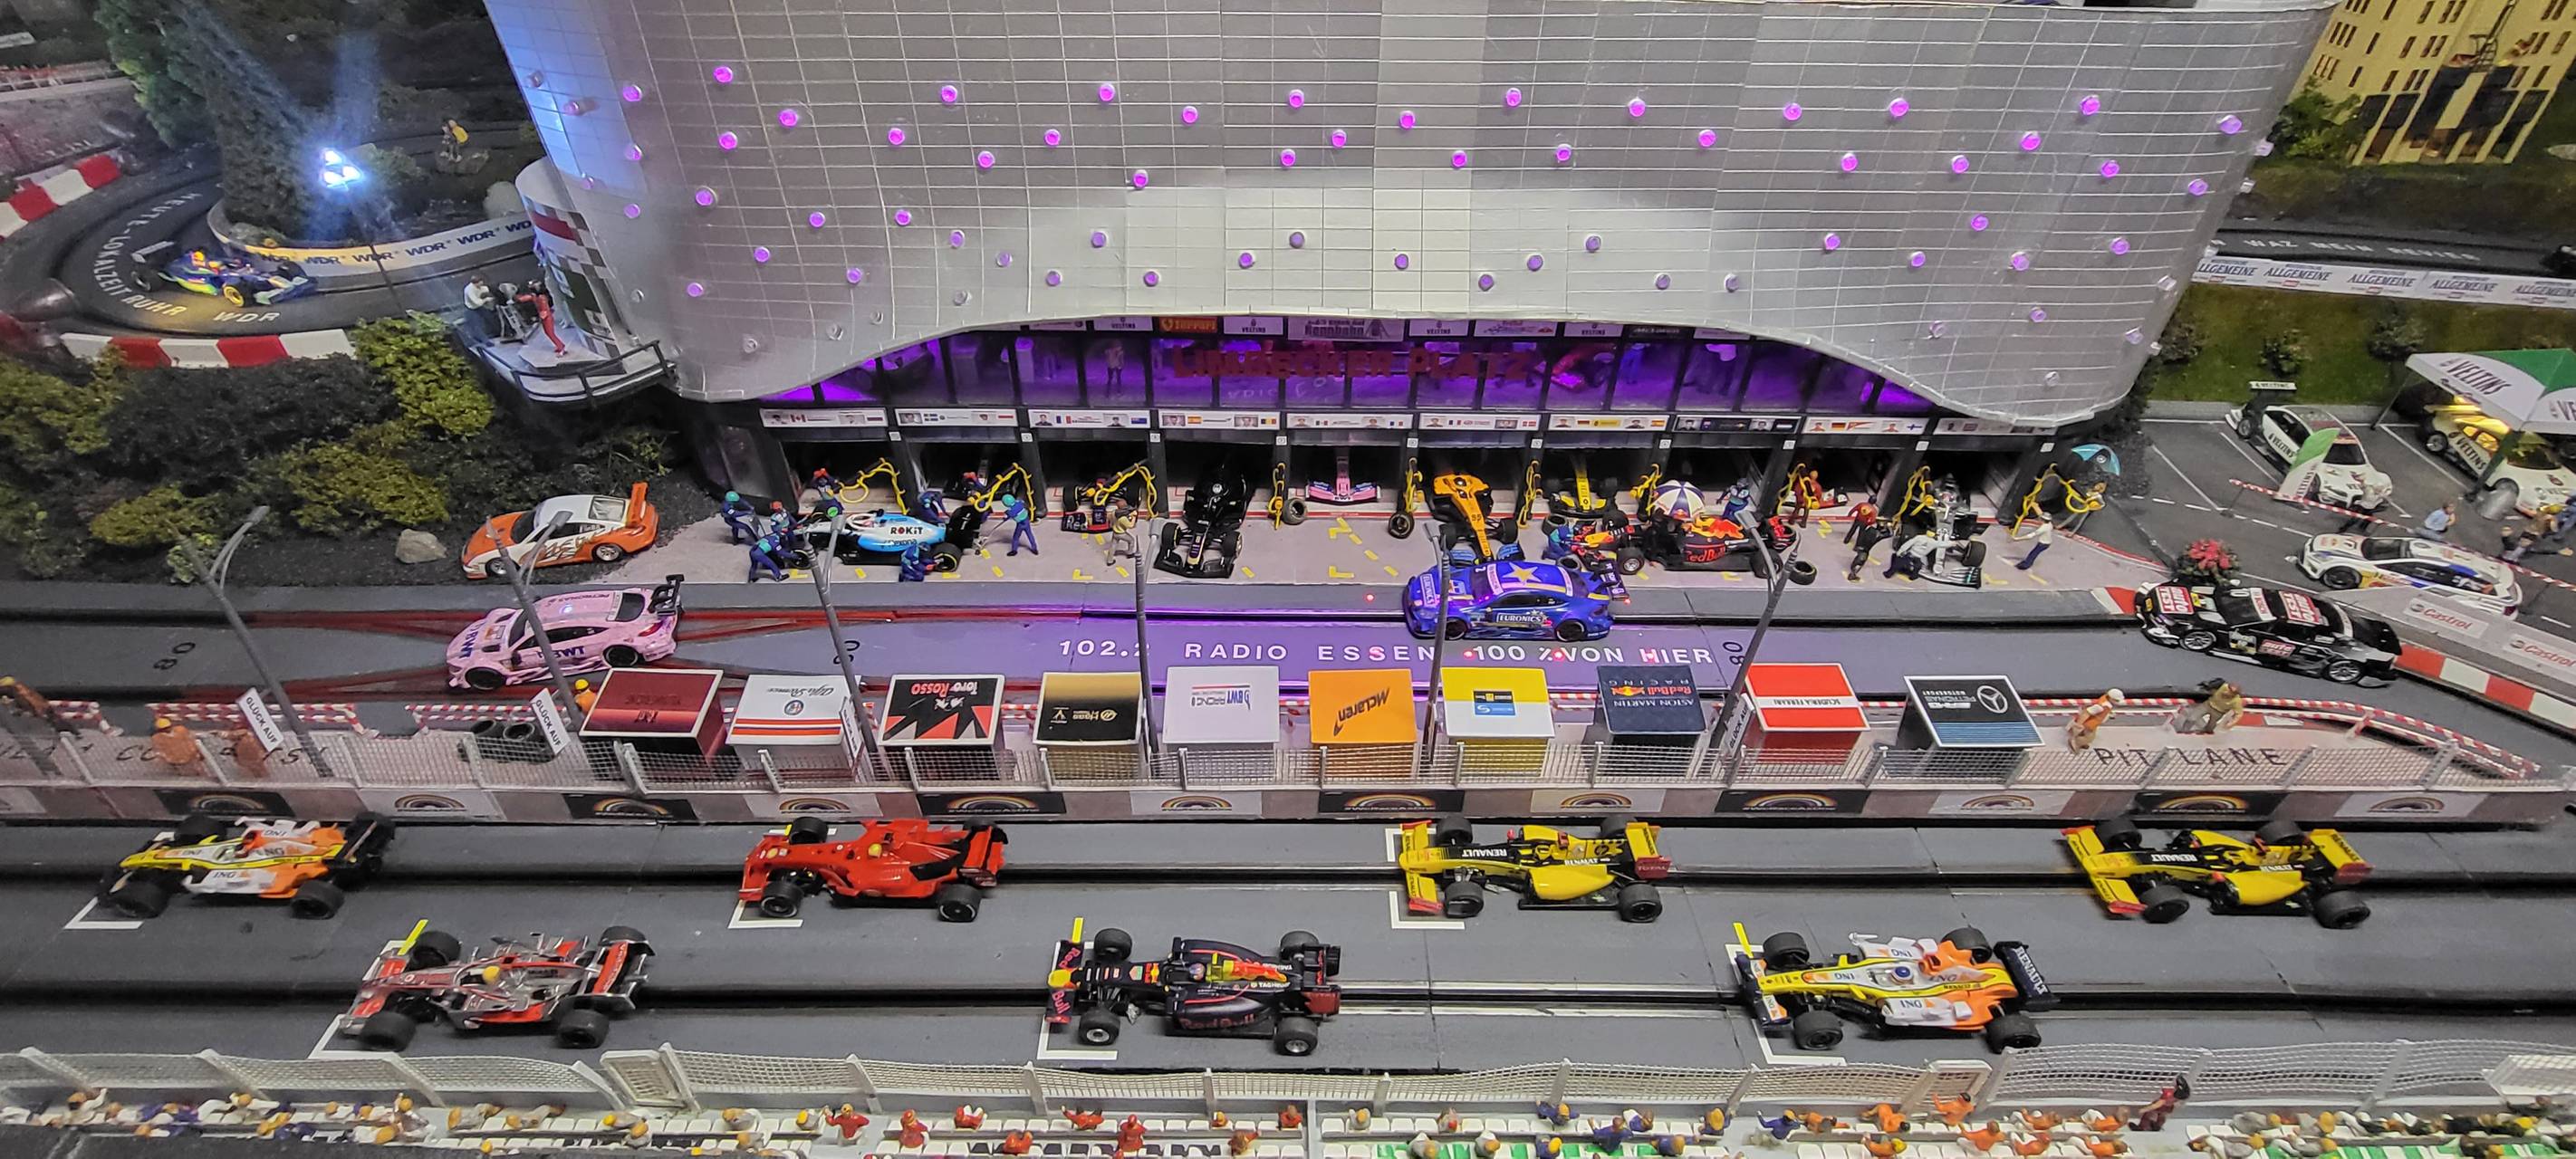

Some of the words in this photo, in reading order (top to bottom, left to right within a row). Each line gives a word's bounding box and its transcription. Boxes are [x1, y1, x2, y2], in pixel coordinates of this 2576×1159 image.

[505, 219, 533, 233] WD
[457, 228, 496, 245] WDR
[405, 240, 447, 257] WDR
[351, 250, 395, 263] WDR
[2197, 262, 2258, 277] LLGEMEINE
[2264, 266, 2332, 282] ALLGEMEINE
[2347, 273, 2416, 288] ALLGEMEINE
[120, 293, 188, 317] RUHR
[212, 311, 281, 323] WDR
[1408, 347, 1529, 381] PLATZ
[2446, 359, 2513, 396] VELTINS
[2272, 435, 2296, 459] VELTINS
[2455, 436, 2487, 471] VELTINS
[1499, 614, 1543, 623] EURONICS
[2423, 608, 2475, 631] Castrol
[1184, 643, 1289, 661] RADIO
[1317, 645, 1436, 662] ESSEN
[1472, 645, 1526, 662] 100
[1560, 647, 1626, 663] VON
[1639, 647, 1714, 665] HIER
[2523, 642, 2575, 667] Castrol
[910, 682, 949, 697] Rosso
[949, 681, 978, 695] Toro
[1226, 689, 1244, 703] BWT
[1612, 699, 1656, 708] MARTIN
[1658, 698, 1695, 707] ASTON
[1925, 694, 1976, 704] PETRONAS
[1338, 686, 1390, 723] McLaren
[245, 695, 265, 726] GLÜCK
[262, 724, 278, 745] AUF
[535, 698, 553, 728] GLÜCK
[549, 727, 562, 748] AUF
[2093, 747, 2153, 767] PIT
[2177, 747, 2287, 766] LANE
[1461, 848, 1508, 857] RENAULT
[2151, 853, 2198, 863] RENAULT
[213, 870, 235, 879] ING
[1637, 863, 1668, 872] TOTAL
[1058, 947, 1081, 969] Red
[1890, 948, 1914, 959] ING
[1834, 972, 1856, 982] ING
[2015, 946, 2049, 996] RENAULT
[1052, 990, 1071, 1013] Bull
[1899, 999, 1923, 1010] ING
[1179, 1017, 1213, 1030] Red
[1214, 1013, 1255, 1030] Bull
